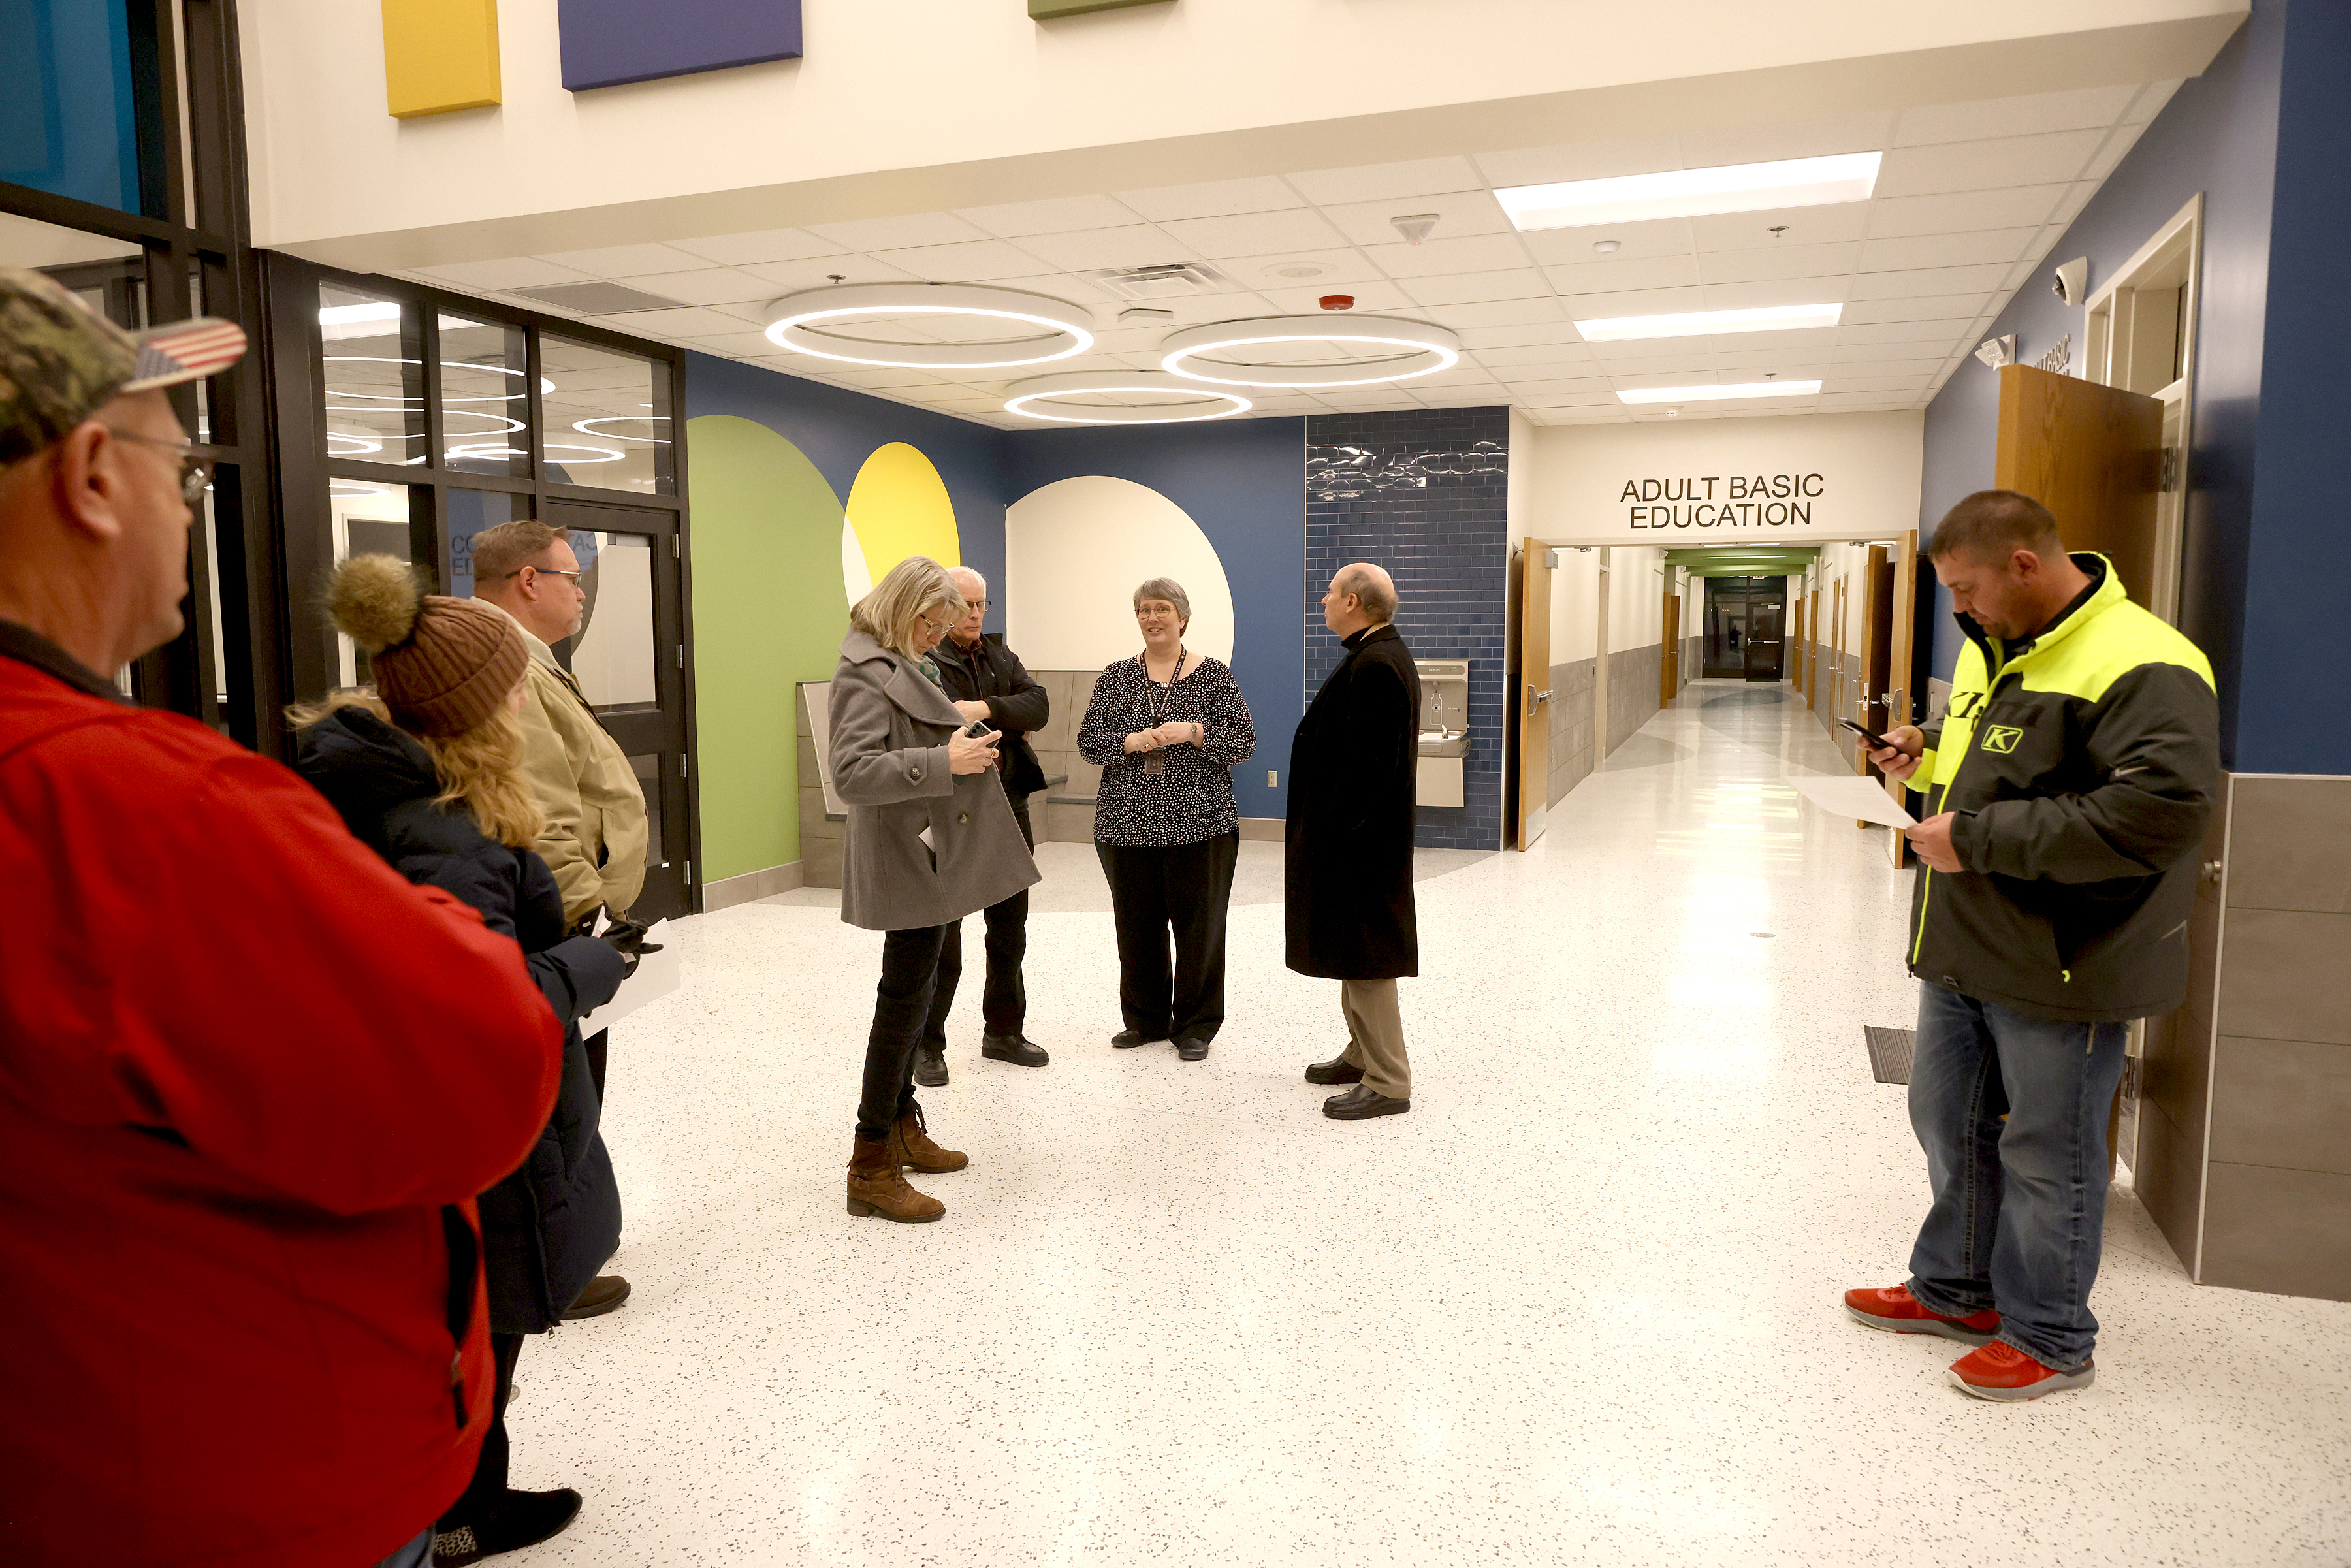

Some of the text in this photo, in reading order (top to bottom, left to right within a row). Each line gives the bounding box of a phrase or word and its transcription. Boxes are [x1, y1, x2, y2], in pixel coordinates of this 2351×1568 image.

[1620, 473, 1824, 503] ADULT BASIC
[1631, 502, 1811, 529] EDUCATION
[1982, 728, 2020, 750] K
